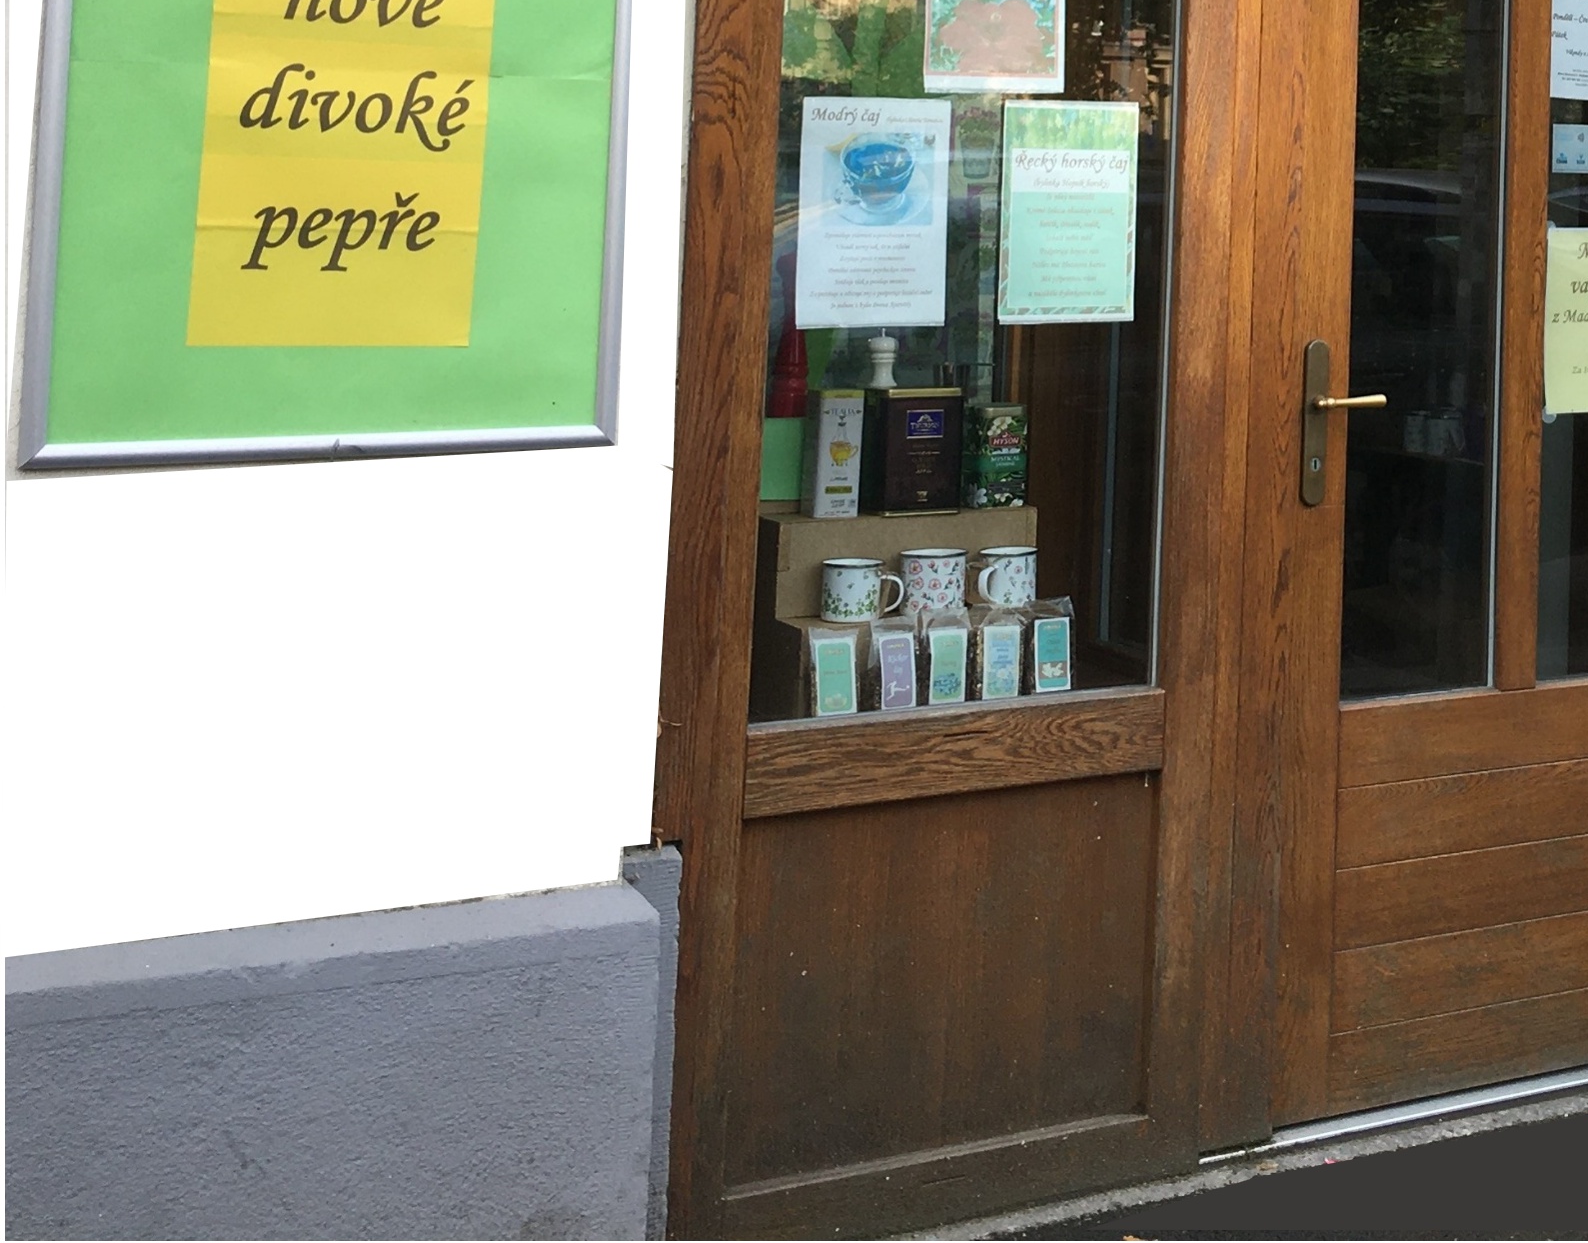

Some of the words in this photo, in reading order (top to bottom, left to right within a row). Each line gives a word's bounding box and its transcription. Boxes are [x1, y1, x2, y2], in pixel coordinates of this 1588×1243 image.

[239, 63, 470, 153] divoké
[811, 106, 858, 126] Modrý
[861, 108, 882, 127] čaj
[1015, 149, 1058, 173] Řecký
[1061, 152, 1106, 174] horský
[1109, 155, 1129, 175] čaj
[241, 191, 441, 273] pepře
[1552, 313, 1560, 323] z
[992, 436, 1020, 445] HYSON
